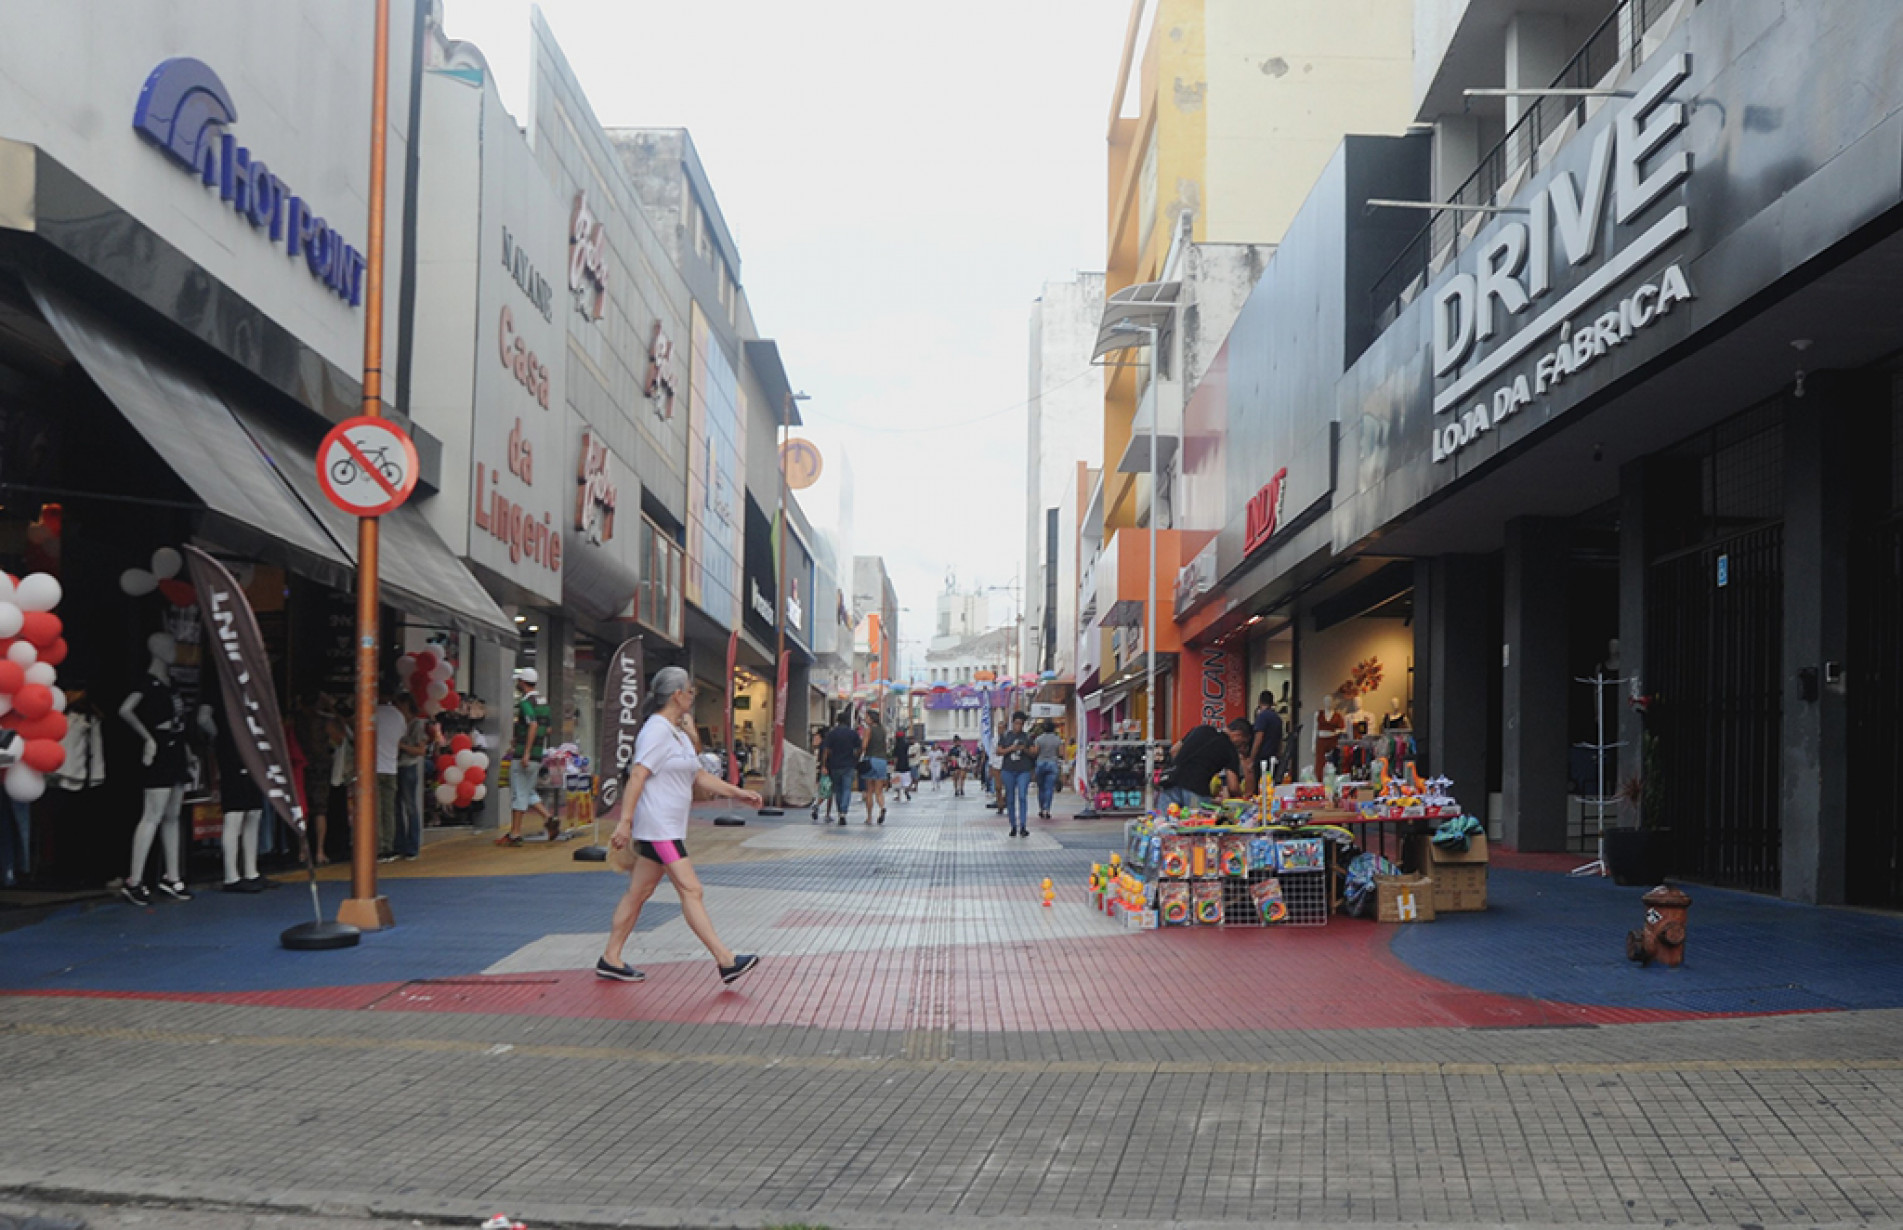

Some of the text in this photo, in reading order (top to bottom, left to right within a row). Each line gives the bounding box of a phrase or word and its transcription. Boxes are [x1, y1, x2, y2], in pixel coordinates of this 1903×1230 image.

[221, 133, 367, 307] HOT POINT
[1433, 52, 1693, 378] DRIVE
[499, 304, 550, 412] Casa
[1432, 263, 1692, 465] LOJA DA FÁBRICA
[508, 416, 533, 487] da
[475, 461, 561, 572] Lingerie
[616, 652, 639, 769] OT POINT
